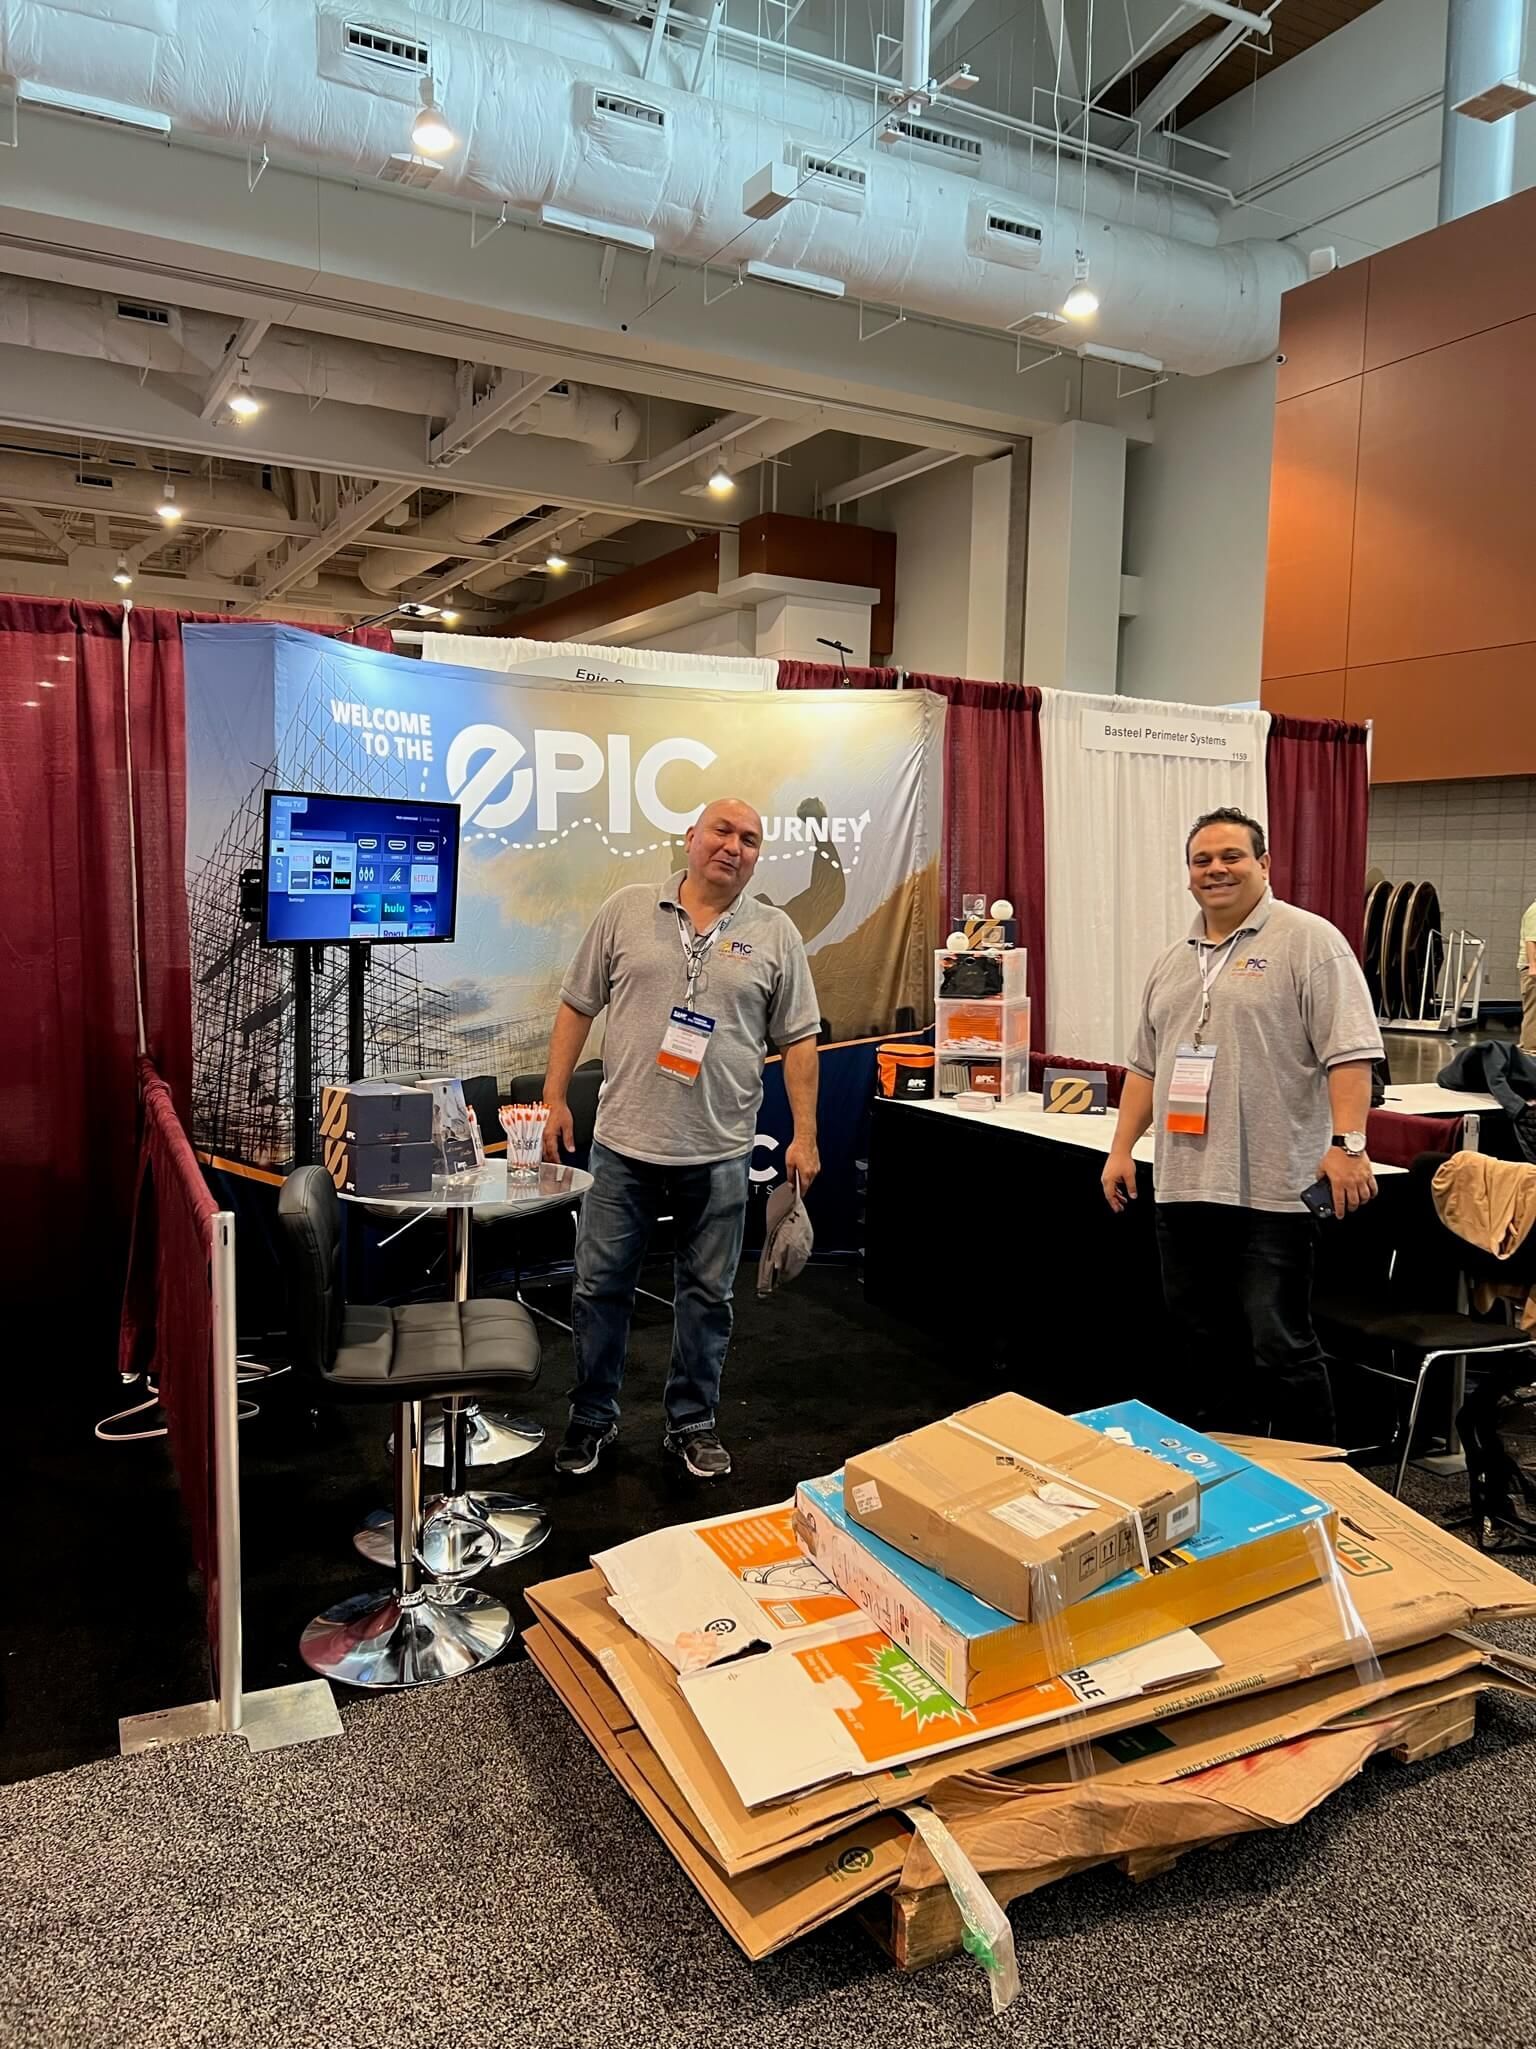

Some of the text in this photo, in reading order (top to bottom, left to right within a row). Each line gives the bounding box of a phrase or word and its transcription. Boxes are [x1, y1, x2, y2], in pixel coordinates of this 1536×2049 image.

[330, 699, 432, 737] WELCOME
[361, 731, 433, 762] TO THE
[1104, 725, 1227, 746] Basteel Perimeter Systems
[1232, 752, 1247, 761] 1159
[761, 815, 866, 843] URNEY
[384, 903, 405, 913] hulu
[888, 1661, 943, 1702] PACK
[1152, 1673, 1267, 1718] SPACE SAVER WARDROBE
